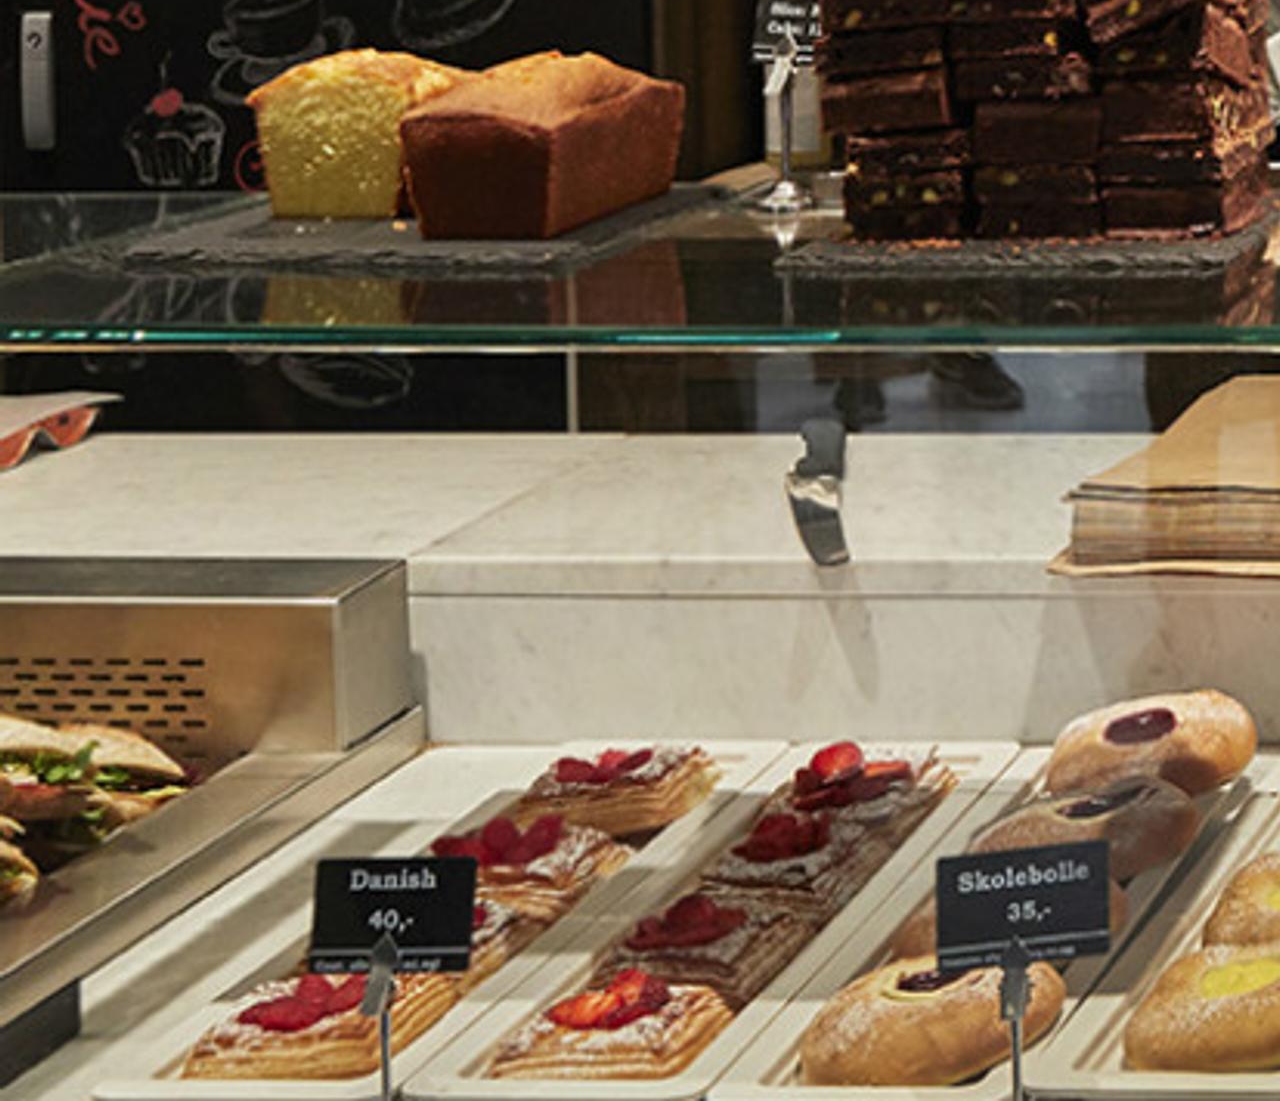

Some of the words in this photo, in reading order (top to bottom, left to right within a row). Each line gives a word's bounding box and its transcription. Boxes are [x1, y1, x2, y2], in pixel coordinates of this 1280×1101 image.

[350, 868, 437, 891] Danish
[957, 859, 1089, 893] Skolebolle
[368, 908, 415, 933] 40,-
